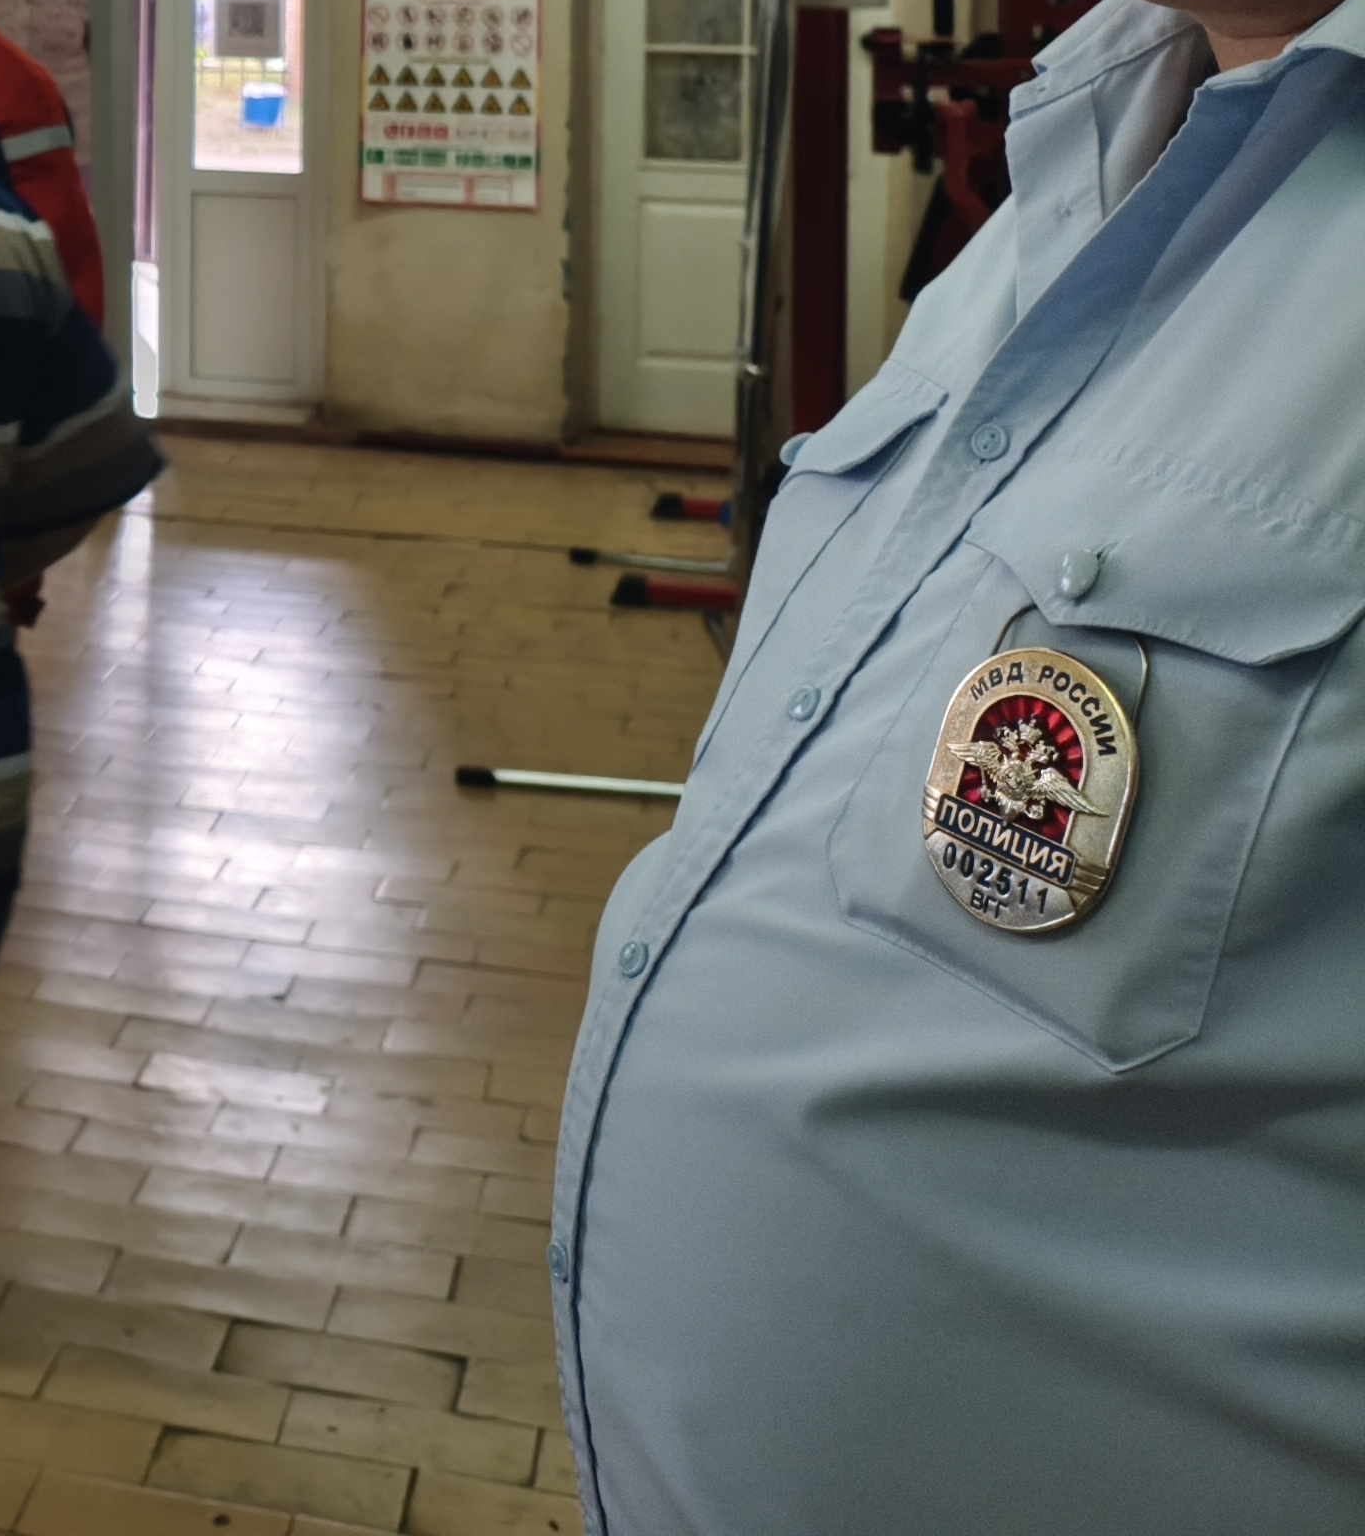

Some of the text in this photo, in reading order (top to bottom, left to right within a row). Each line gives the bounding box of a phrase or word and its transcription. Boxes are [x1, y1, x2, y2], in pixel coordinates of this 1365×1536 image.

[970, 662, 1118, 756] МВД РОССИИ
[938, 798, 1069, 883] ПОЛИЦИЯ
[943, 842, 1049, 914] 002511
[970, 889, 1009, 920] ВГГ
